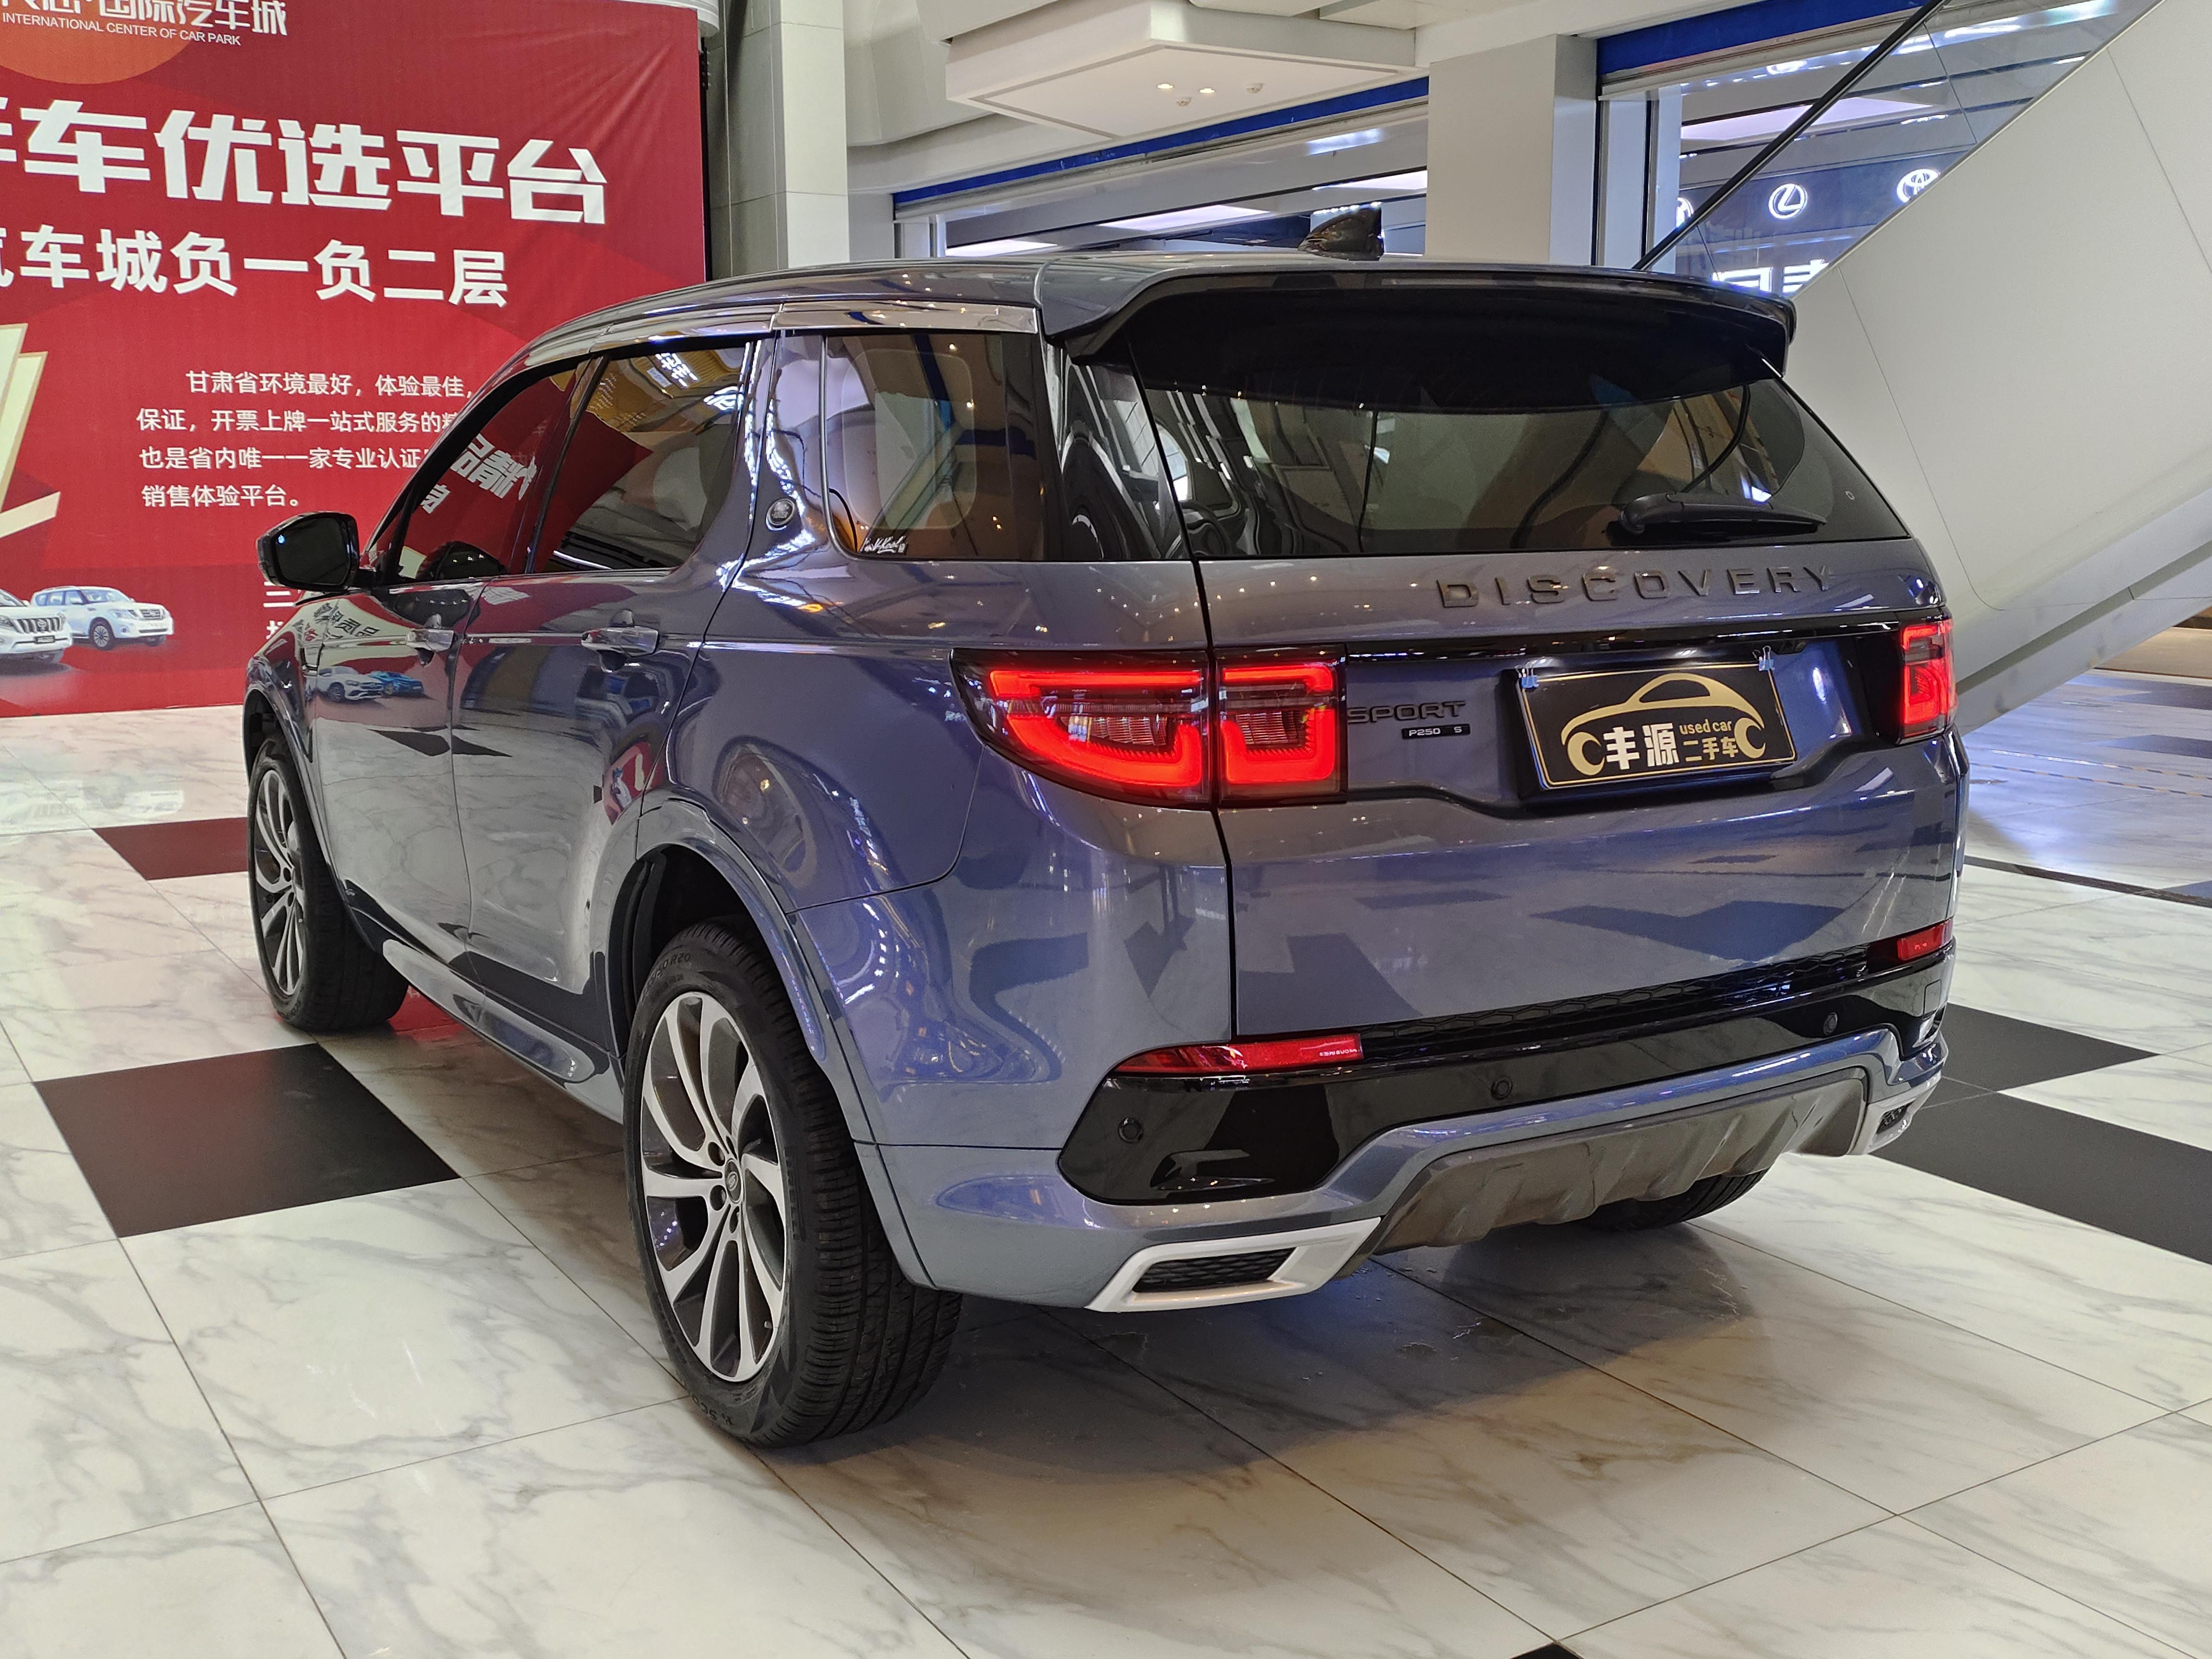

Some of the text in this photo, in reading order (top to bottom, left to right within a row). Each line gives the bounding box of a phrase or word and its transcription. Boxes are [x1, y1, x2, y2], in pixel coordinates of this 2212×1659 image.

[2, 12, 241, 46] INTERNATIONAL CENTER OF CAR PARK
[139, 445, 429, 469] 也是省内唯一一家专业认证
[1436, 565, 1832, 608] DISCOVERY
[1346, 700, 1466, 725] SPORT
[1409, 726, 1463, 737] P250 S
[1679, 719, 1732, 735] used car
[1603, 722, 1680, 770] 丰源
[1683, 736, 1739, 762] 二手车
